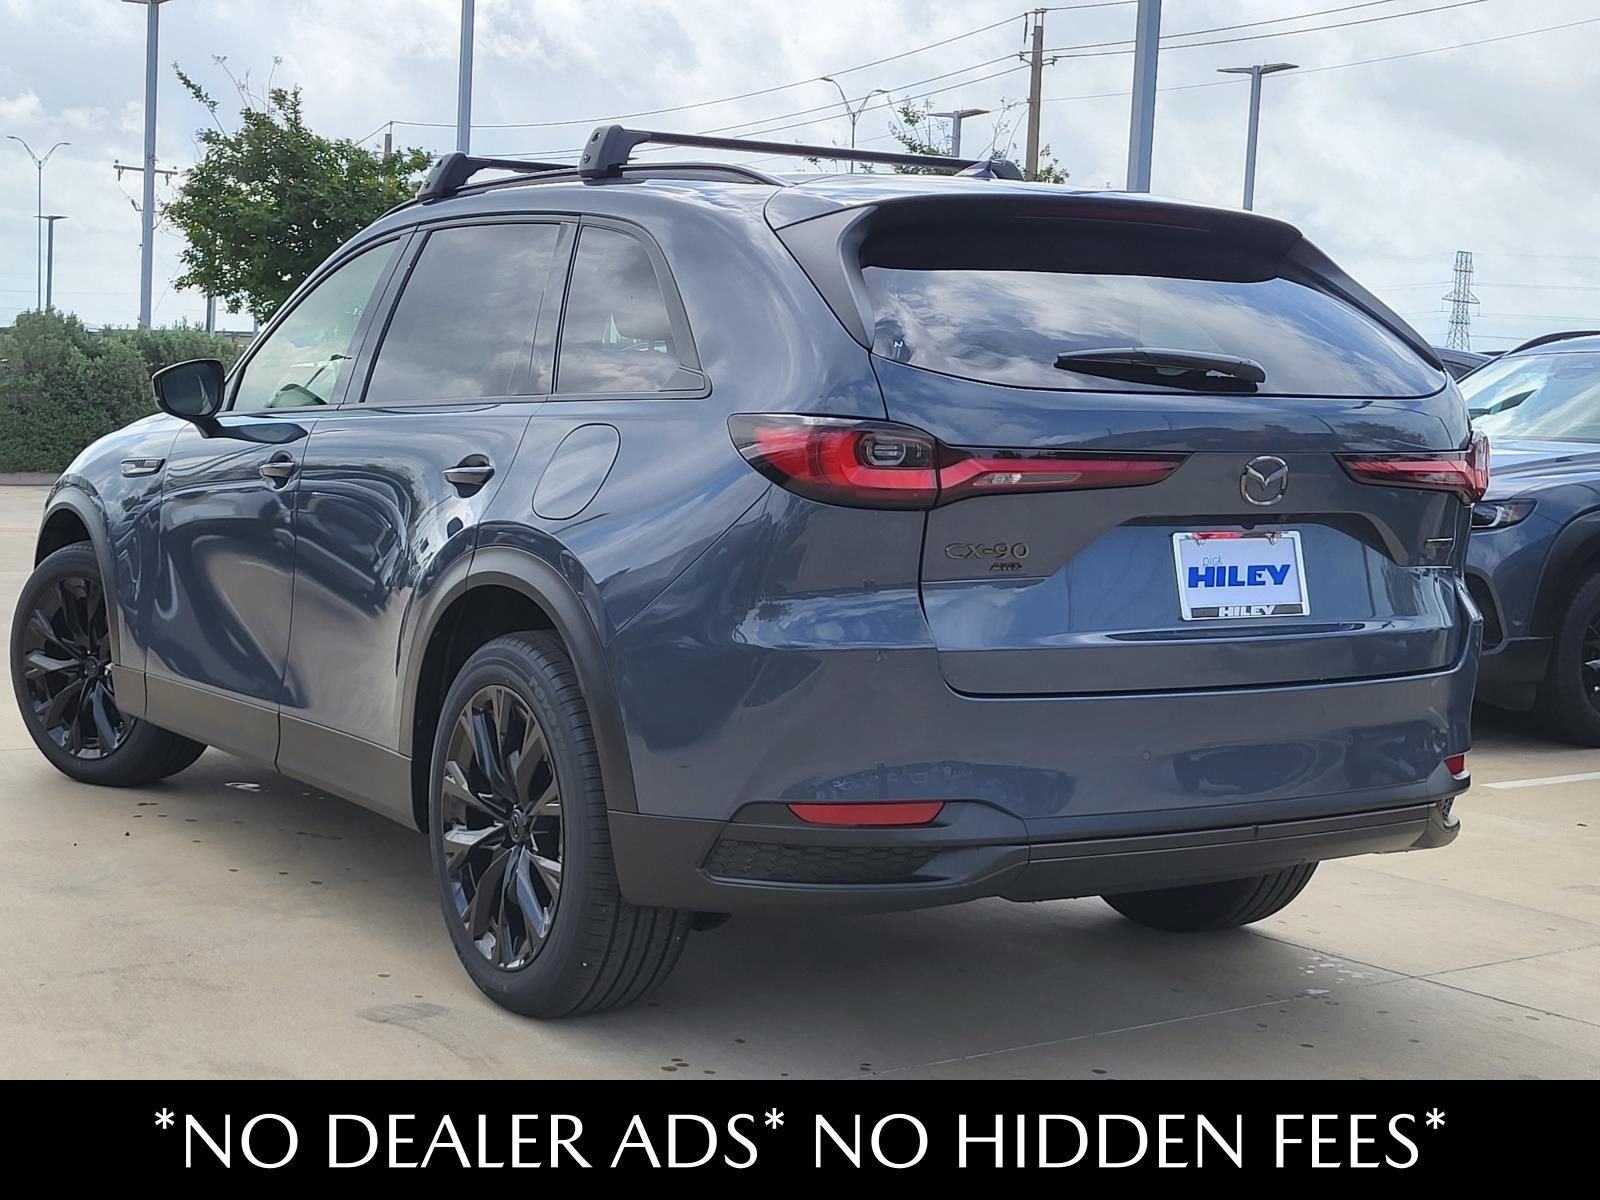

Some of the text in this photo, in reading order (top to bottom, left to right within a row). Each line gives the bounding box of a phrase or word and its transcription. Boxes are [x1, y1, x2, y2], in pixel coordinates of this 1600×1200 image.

[944, 542, 1030, 560] CX-90
[1188, 564, 1291, 589] HILEY
[1218, 604, 1276, 618] HILEY
